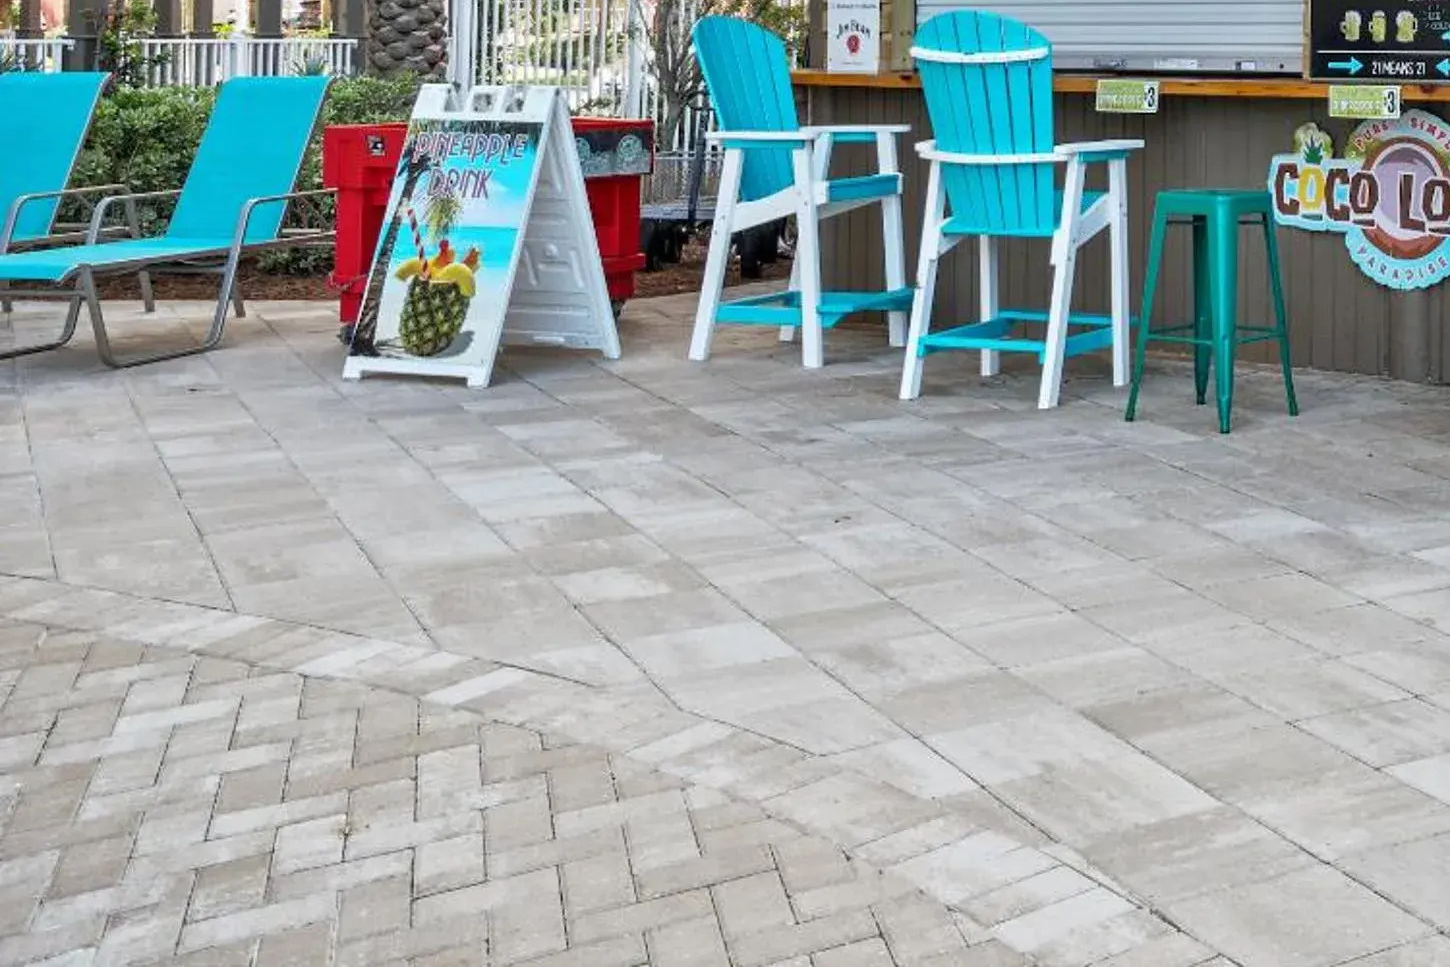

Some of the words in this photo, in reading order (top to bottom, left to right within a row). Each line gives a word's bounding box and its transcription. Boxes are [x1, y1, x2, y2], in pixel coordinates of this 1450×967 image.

[412, 132, 528, 164] PINEAPPLE
[428, 167, 492, 198] DRINK
[1275, 163, 1379, 222] COCO
[1357, 244, 1448, 280] PARADISE
